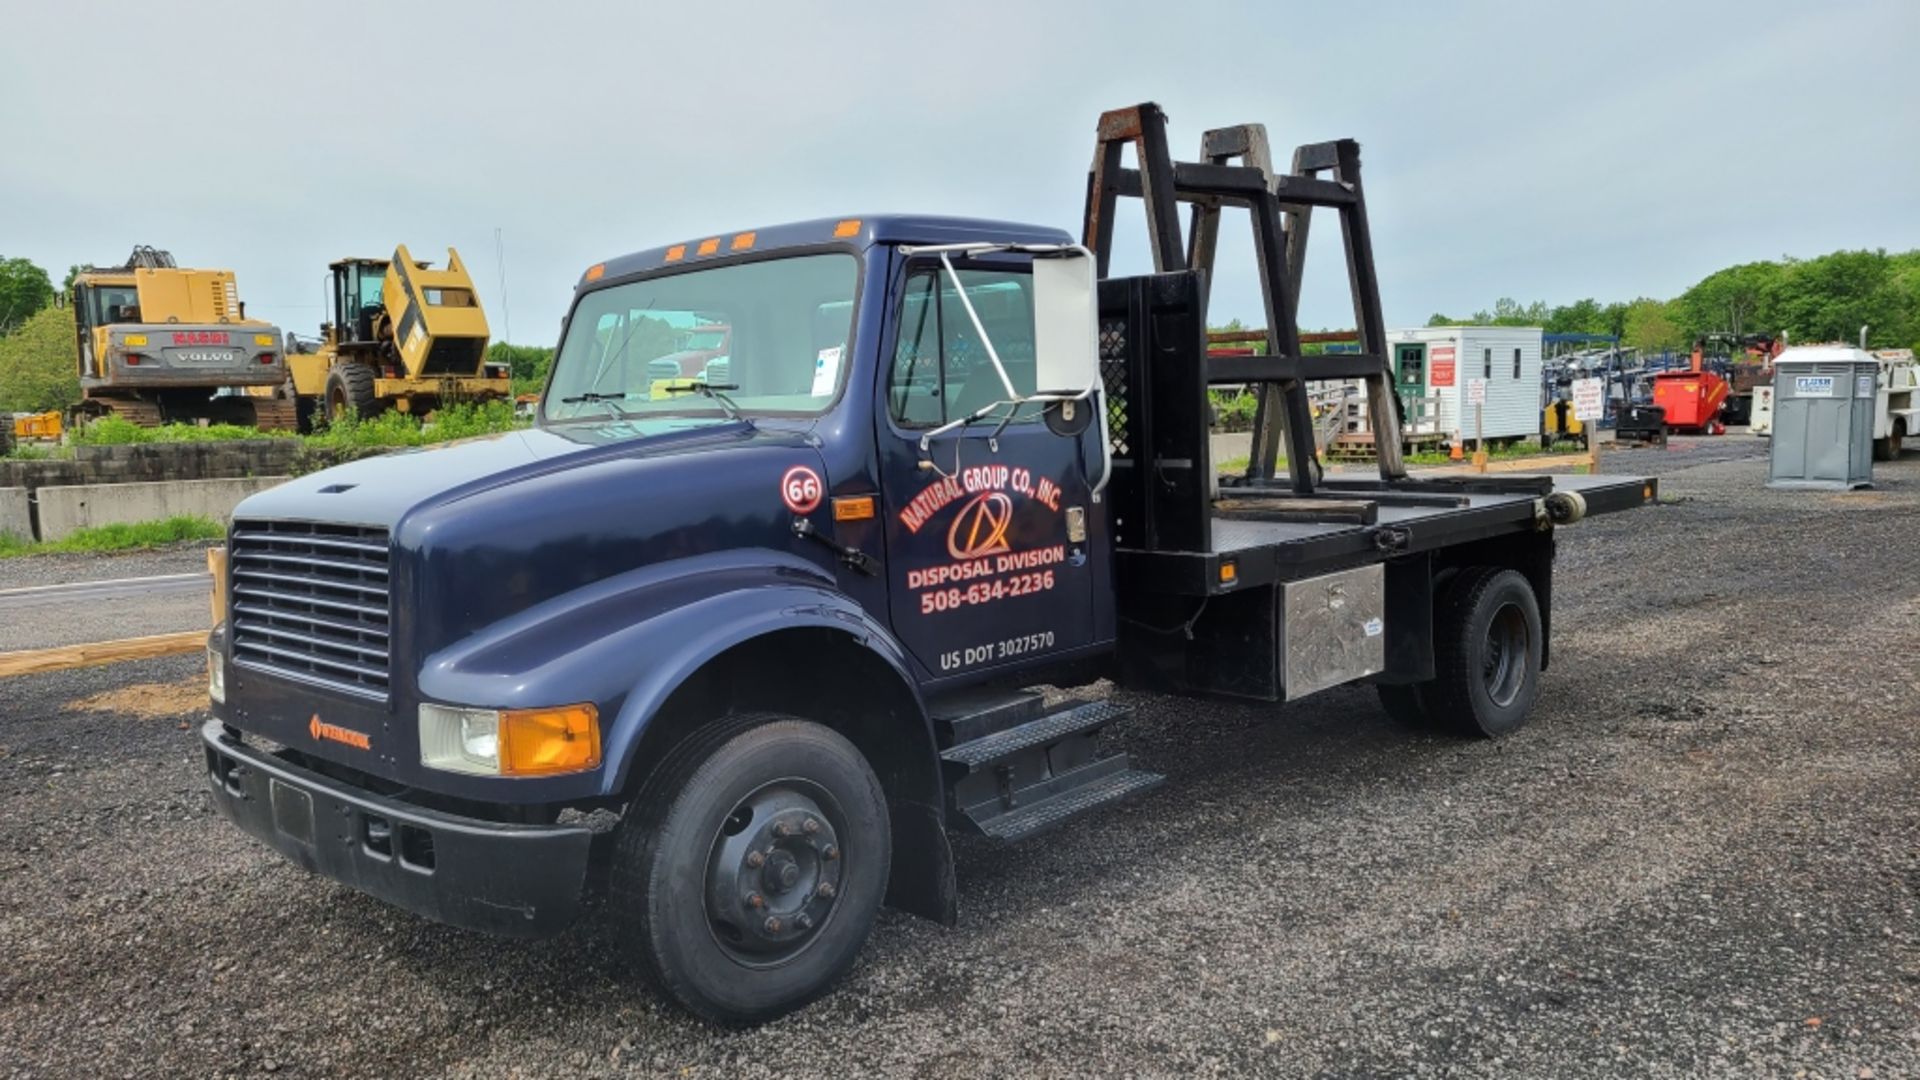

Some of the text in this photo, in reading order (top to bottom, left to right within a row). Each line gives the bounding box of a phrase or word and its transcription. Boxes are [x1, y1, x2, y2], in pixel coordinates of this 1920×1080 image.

[177, 351, 233, 361] VOLVO
[788, 478, 817, 502] 66
[900, 476, 964, 534] NATURAL
[963, 466, 1009, 493] GROUP
[908, 545, 1065, 590] DISPOSAL DIVISION
[920, 570, 1055, 615] 508-634-2236
[940, 631, 1055, 670] US DOT 3027570
